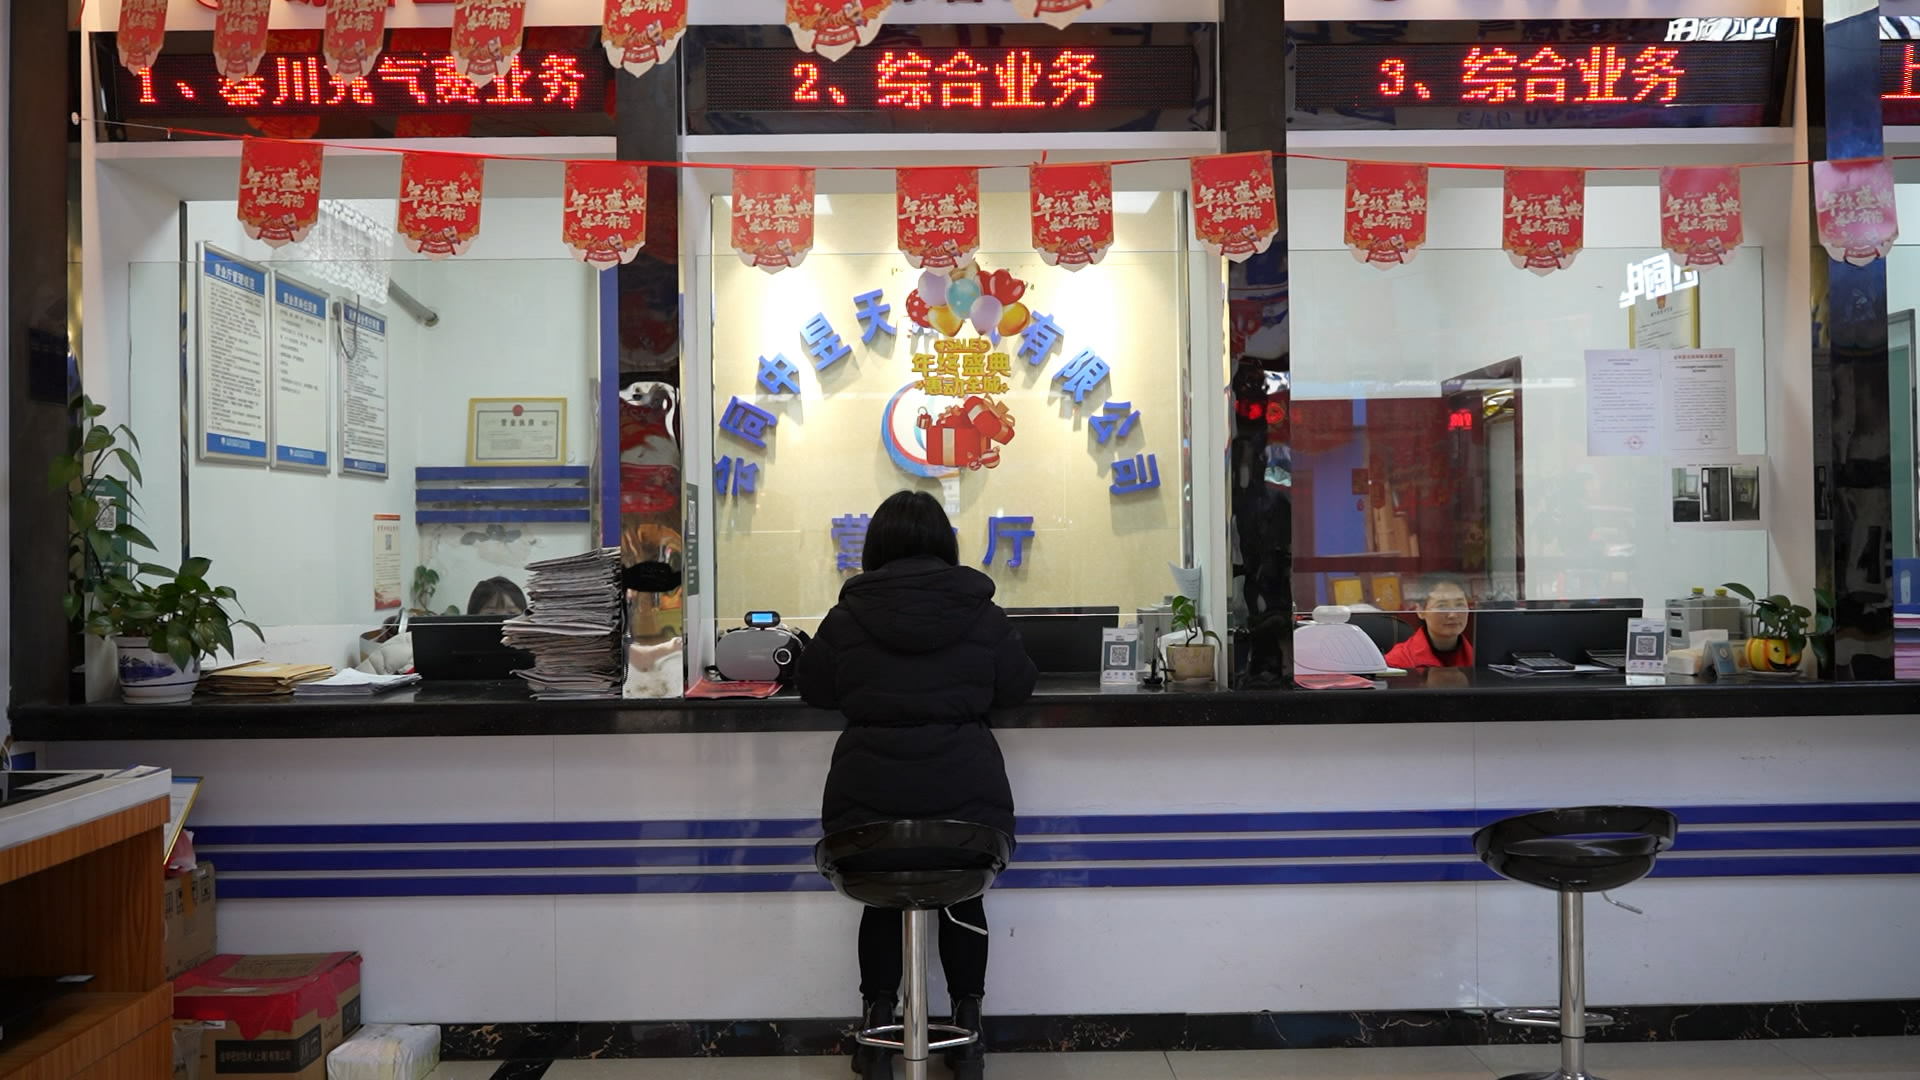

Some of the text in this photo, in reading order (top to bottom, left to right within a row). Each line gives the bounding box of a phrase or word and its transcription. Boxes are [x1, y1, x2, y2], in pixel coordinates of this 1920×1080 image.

[792, 51, 1103, 110] 2、综合业务
[1379, 45, 1685, 104] 3、综合业务
[240, 167, 319, 193] 年终盛典
[400, 179, 481, 207] 年终盛典
[565, 189, 645, 217] 年终盛典
[734, 194, 812, 222] 年终盛典
[898, 194, 978, 224] 年终盛典
[1032, 191, 1112, 221] 年终盛典
[1194, 179, 1273, 213] 年终盛典
[1346, 190, 1425, 218] 年终盛典
[1503, 194, 1583, 222] 年终盛典
[1661, 194, 1742, 222] 年终盛典
[1817, 187, 1892, 214] 年终盛典
[912, 352, 1011, 377] 年终盛典
[925, 376, 1001, 398] 惠动全城
[831, 513, 1035, 571] 营厅
